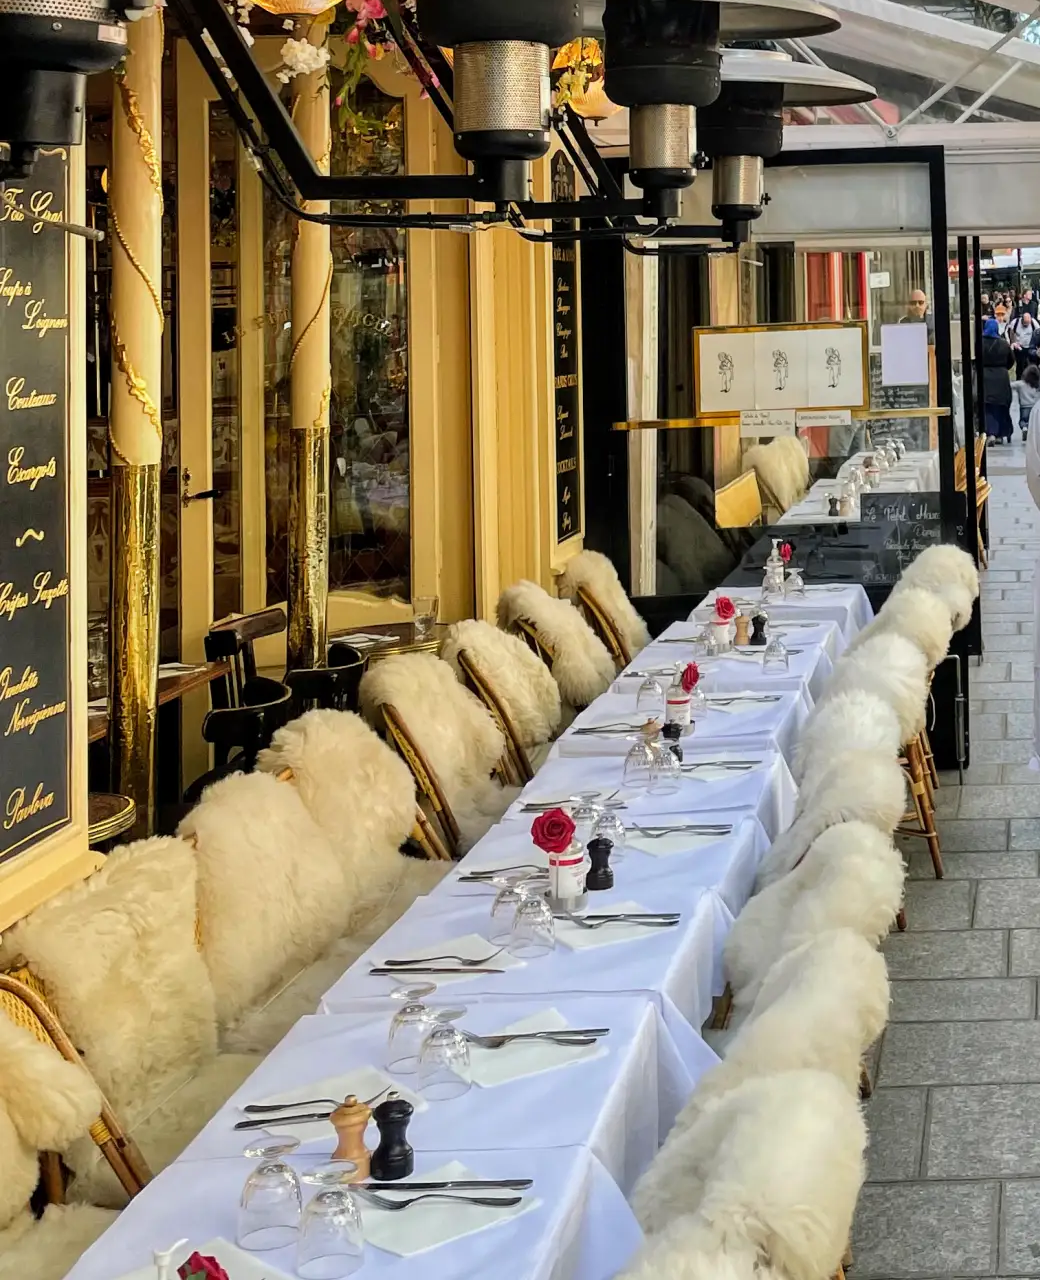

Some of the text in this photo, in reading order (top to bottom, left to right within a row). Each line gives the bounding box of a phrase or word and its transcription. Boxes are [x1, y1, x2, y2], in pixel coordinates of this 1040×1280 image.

[30, 190, 64, 233] Gras
[24, 282, 32, 295] à
[22, 299, 68, 338] L'oignon
[6, 376, 57, 411] Couteaux
[7, 446, 56, 490] Escargots
[32, 571, 69, 609] Suzette
[4, 698, 66, 736] Norvégienne
[4, 782, 54, 830] Pavlova
